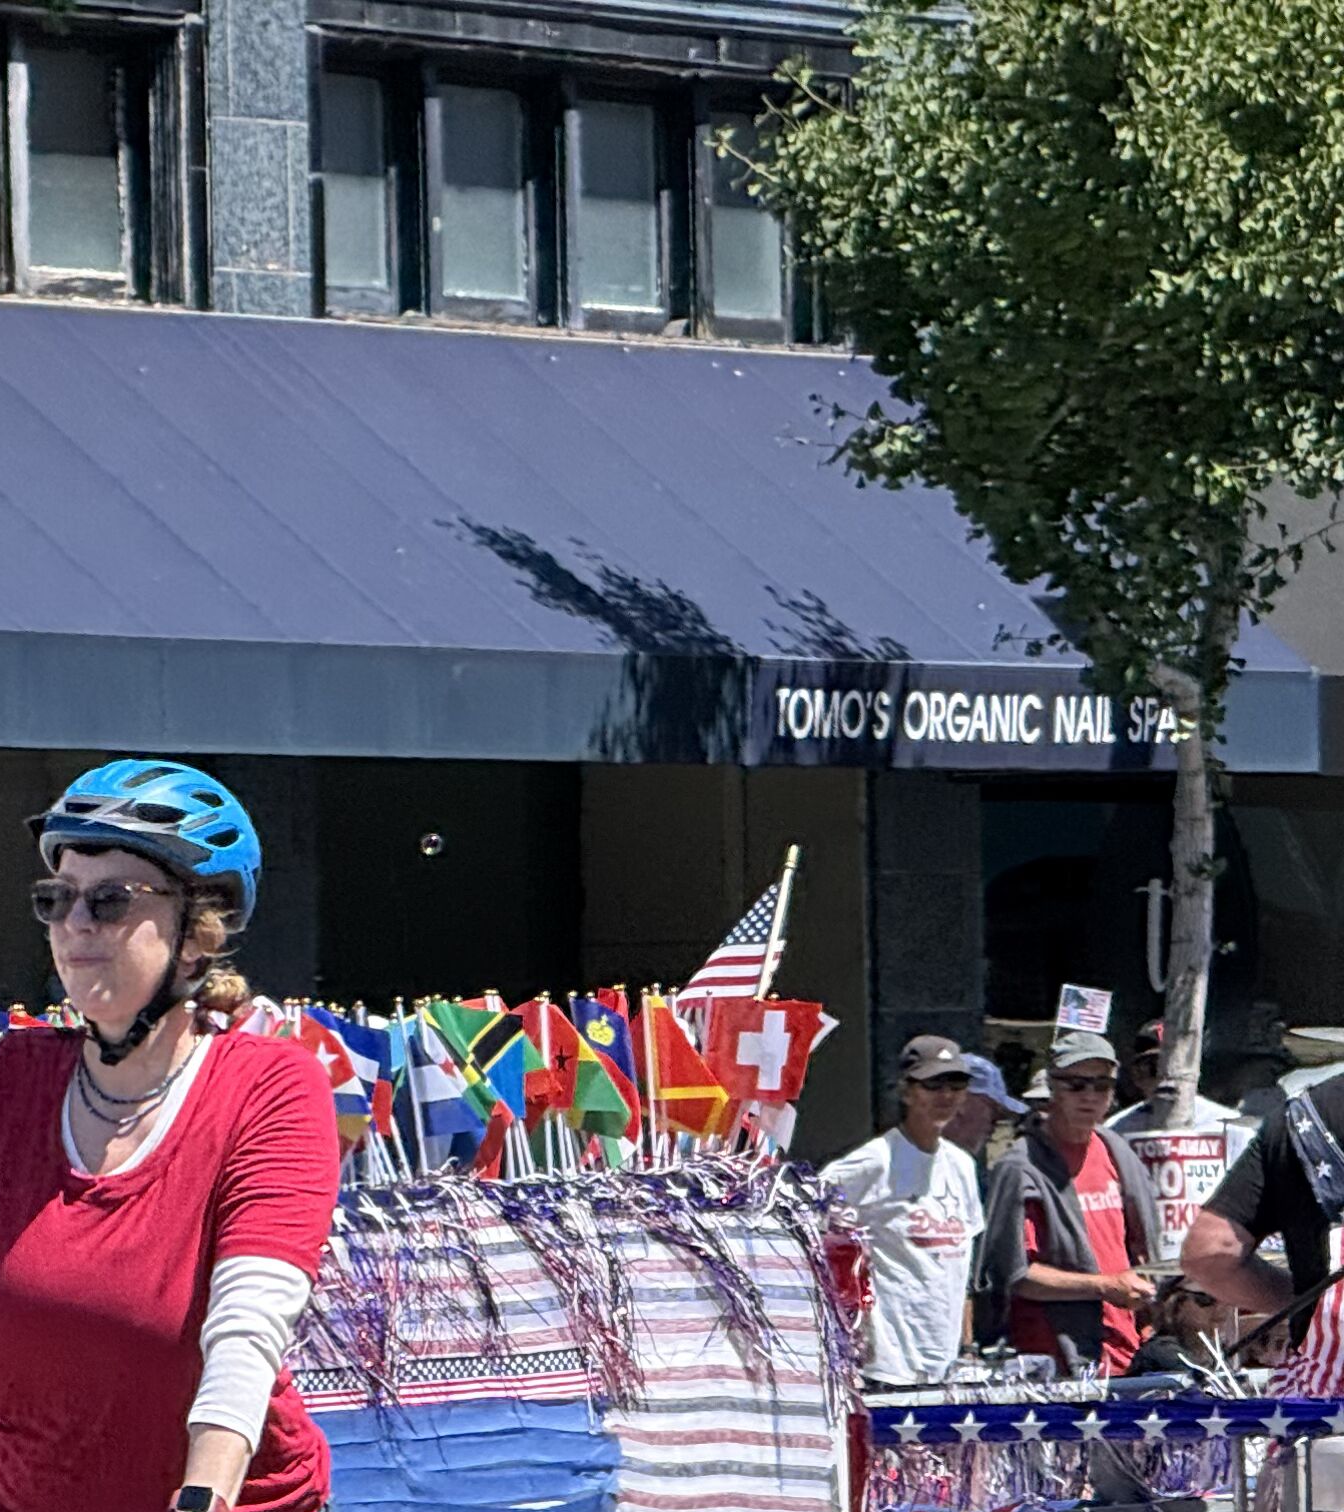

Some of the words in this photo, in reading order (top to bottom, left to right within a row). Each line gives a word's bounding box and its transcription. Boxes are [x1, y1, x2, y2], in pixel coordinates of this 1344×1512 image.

[776, 687, 890, 739] TOMO'S
[903, 690, 1044, 744] ORGANIC
[1054, 694, 1116, 744] NAIL
[1127, 695, 1179, 744] SPA
[1186, 1164, 1220, 1178] JULY
